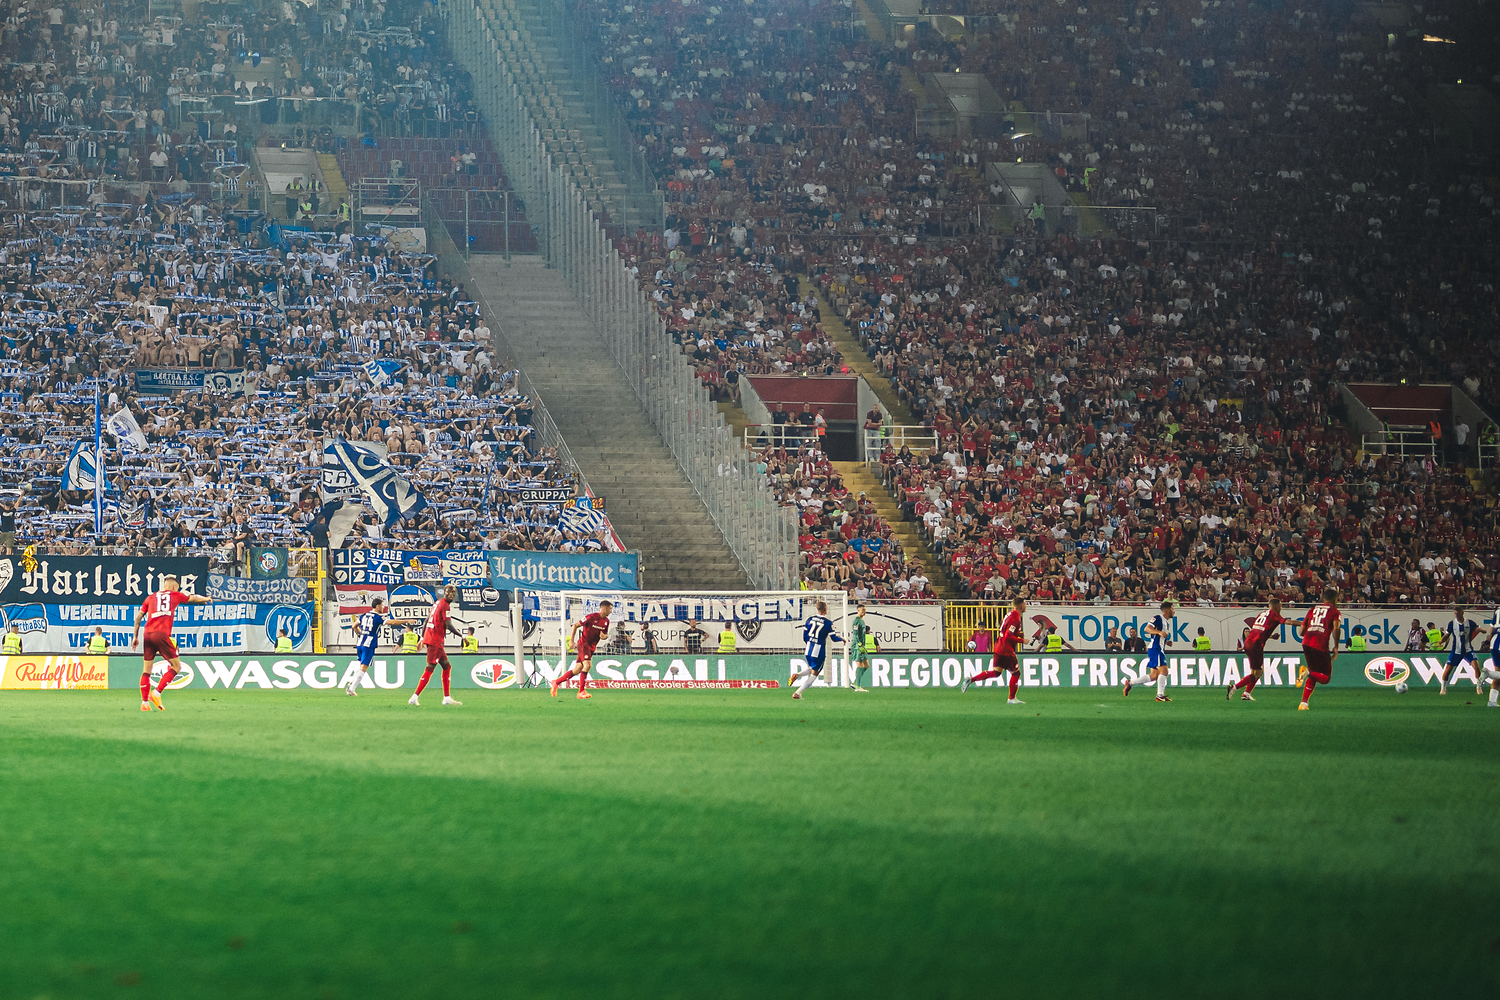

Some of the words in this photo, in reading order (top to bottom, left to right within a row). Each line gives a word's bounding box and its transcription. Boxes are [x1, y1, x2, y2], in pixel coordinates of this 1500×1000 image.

[522, 489, 570, 500] GRUPPA!
[370, 549, 402, 560] SPREE
[447, 563, 483, 576] SÜD
[493, 556, 615, 584] Lichtenrade
[227, 578, 290, 593] SEKTION
[369, 573, 401, 584] MACHT
[448, 579, 483, 588] BERLIN
[156, 593, 171, 612] 13
[206, 587, 306, 604] STADIONVERBOT
[59, 605, 129, 620] VEREINT
[194, 604, 257, 620] FARBEN
[625, 598, 802, 621] HATTINGEN
[1310, 609, 1326, 626] 32
[276, 614, 301, 637] KSC
[808, 621, 824, 638] 27
[202, 631, 242, 648] ALLE
[15, 662, 62, 681] Rudolf
[64, 662, 106, 681] Weber
[195, 660, 405, 689] WASGAU
[872, 658, 1059, 687] REGIONALER
[1071, 658, 1300, 688] FRISCHEMARKT
